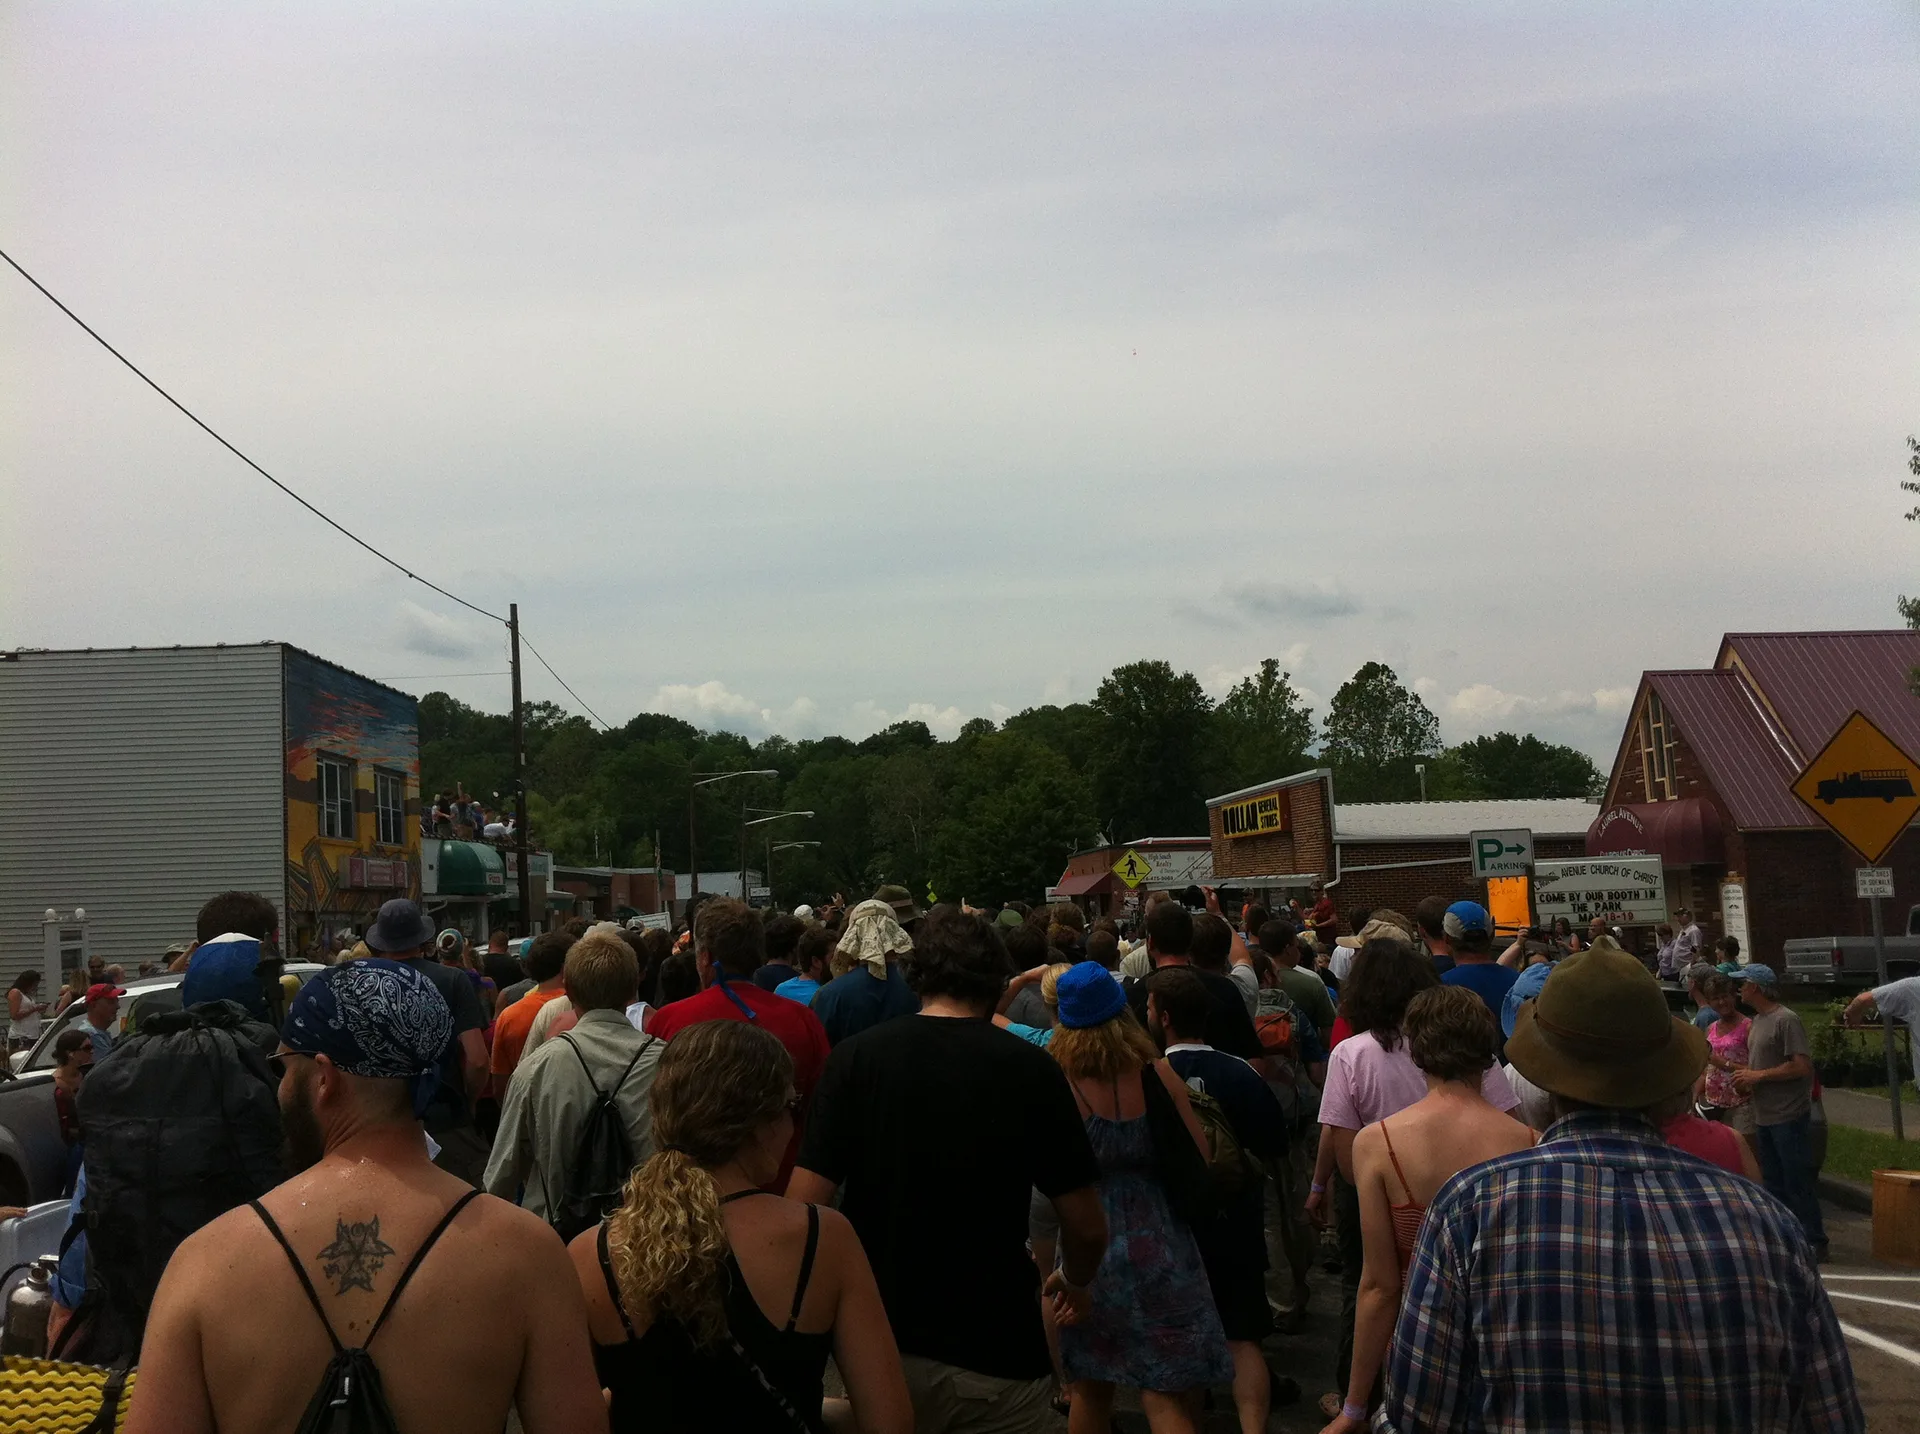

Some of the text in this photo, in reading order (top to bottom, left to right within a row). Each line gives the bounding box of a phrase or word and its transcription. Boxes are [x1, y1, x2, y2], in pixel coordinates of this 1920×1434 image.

[1598, 807, 1644, 838] LAUREL AVENUE
[1561, 865, 1587, 878] AVENUE
[1590, 864, 1619, 876] CHURCH
[1621, 867, 1631, 878] OF
[1633, 870, 1658, 886] CHRIST
[1539, 890, 1656, 903] COME BY OUR BOOTH IN
[1571, 902, 1622, 913] THE PARK
